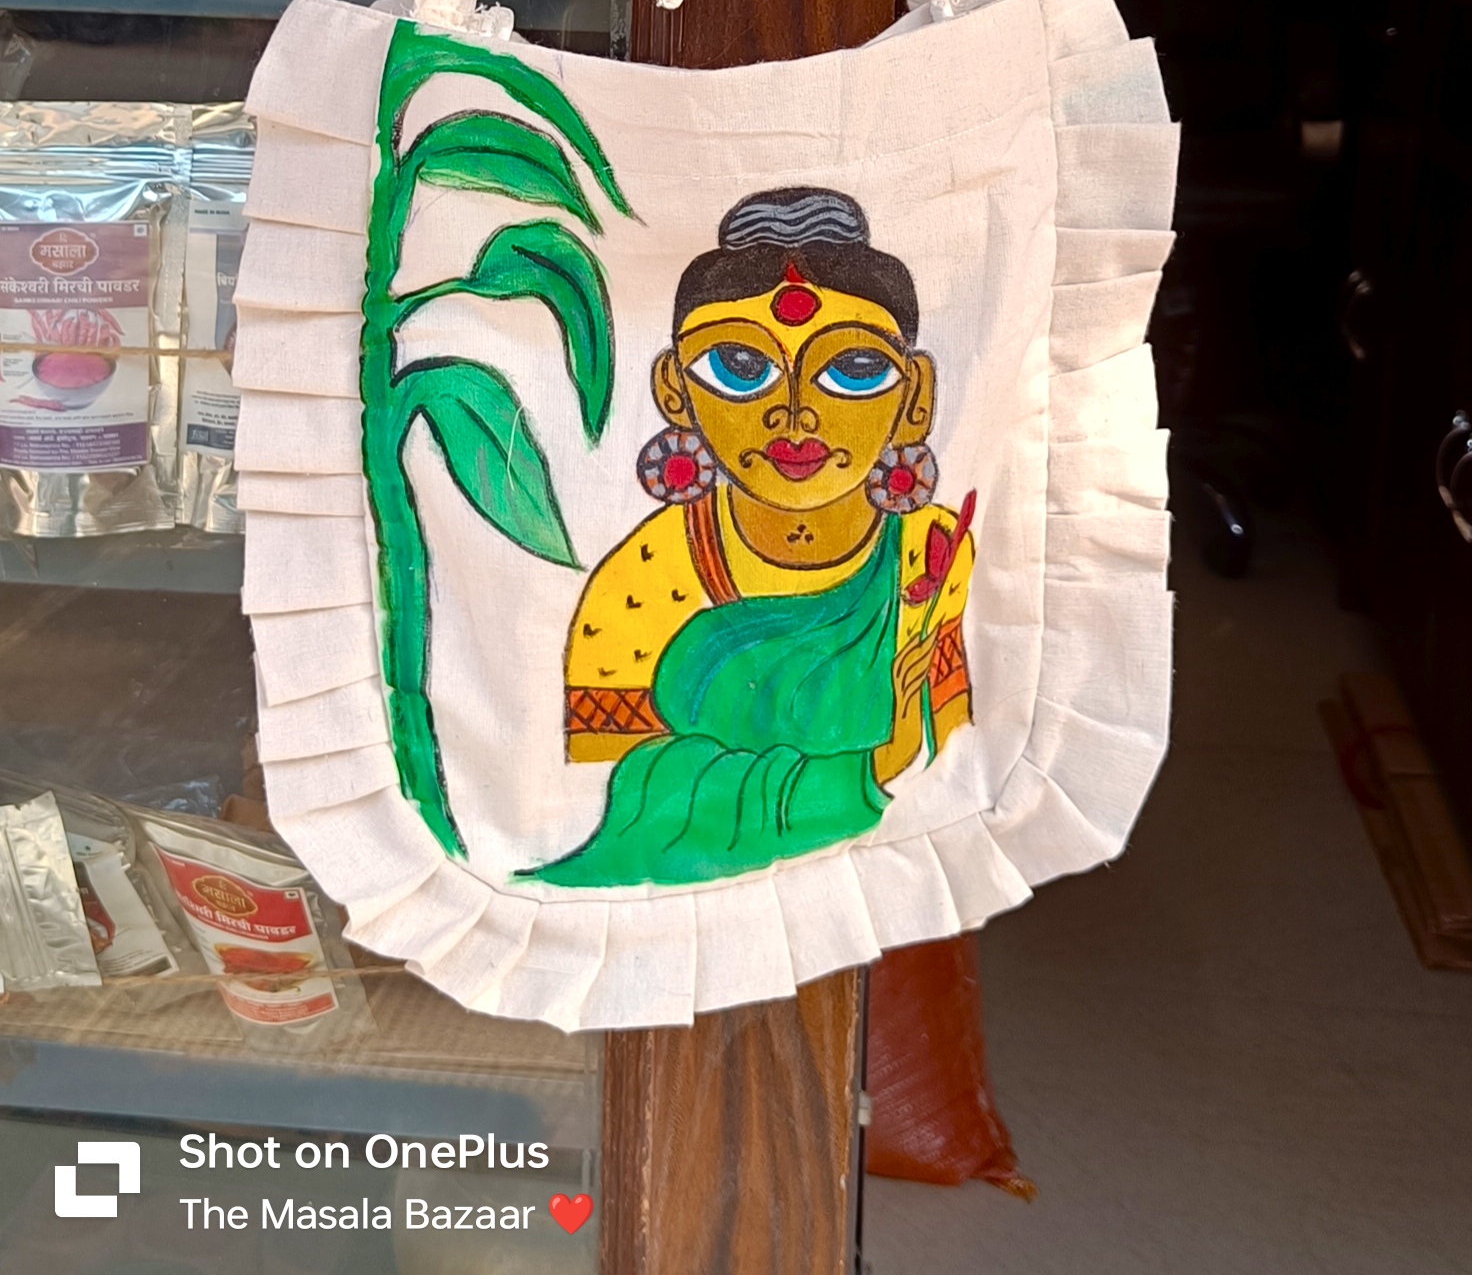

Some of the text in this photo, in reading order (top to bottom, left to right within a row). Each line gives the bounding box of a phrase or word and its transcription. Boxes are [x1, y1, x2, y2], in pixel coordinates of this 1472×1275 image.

[40, 244, 87, 258] मसाला
[53, 276, 93, 294] मिरची
[96, 279, 141, 293] पावडर
